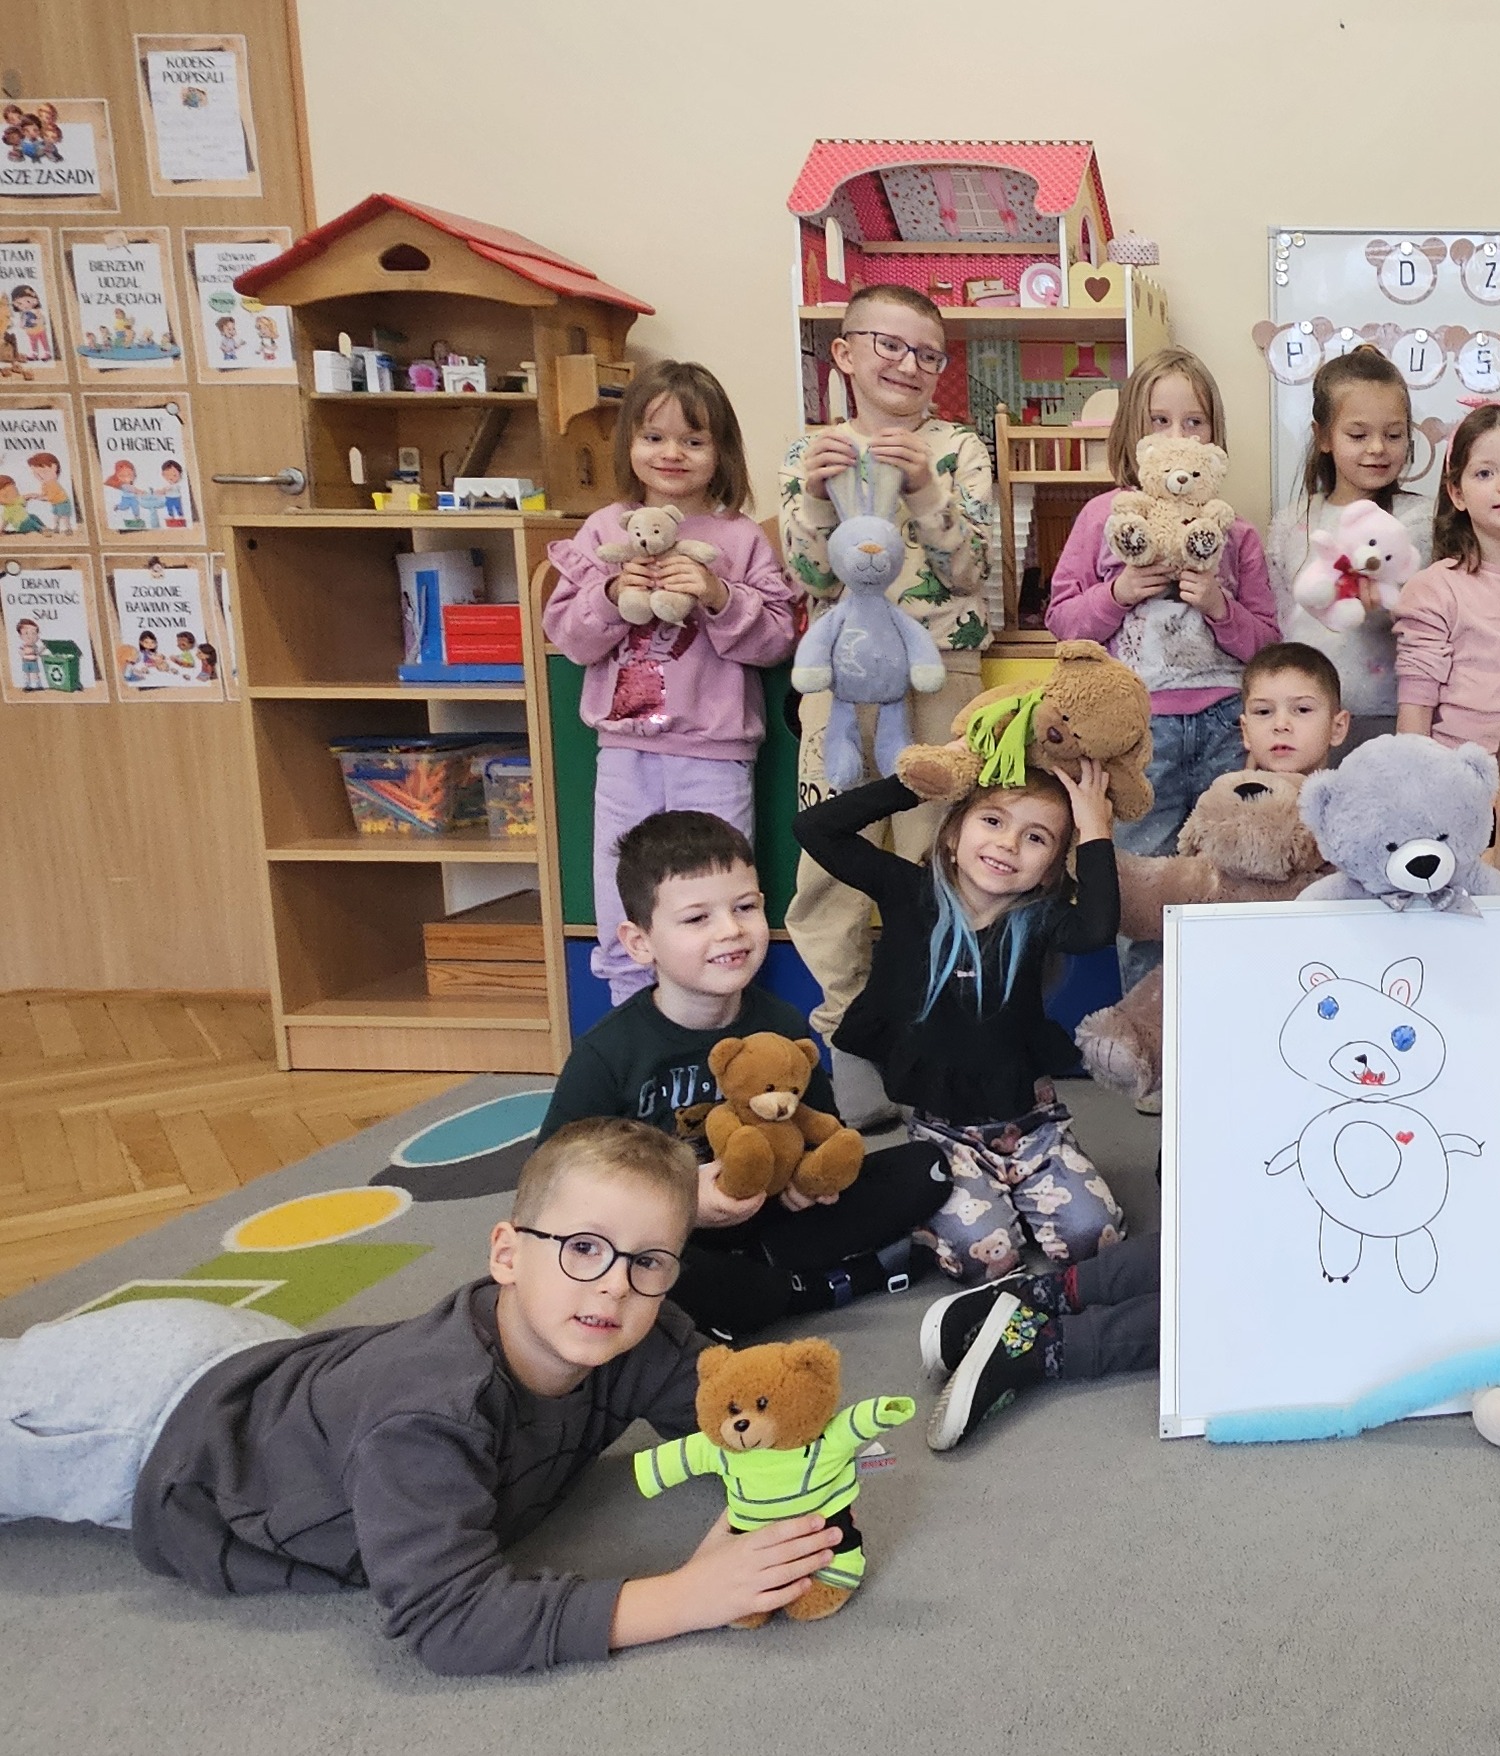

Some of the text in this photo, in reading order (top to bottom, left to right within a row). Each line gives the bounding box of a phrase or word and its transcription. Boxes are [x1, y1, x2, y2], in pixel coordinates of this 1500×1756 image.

[165, 56, 216, 69] KODEKS
[162, 71, 225, 84] PODPISALI
[0, 169, 95, 185] SZE ZASADY
[0, 250, 35, 262] TAMY
[89, 260, 145, 272] BIERZEMY
[81, 293, 92, 304] W
[112, 417, 163, 431] DBAMY
[106, 437, 175, 454] O HIGIENĘ
[21, 578, 60, 589] DBAMY
[131, 585, 182, 597] ZGODNIE
[7, 593, 16, 605] O
[136, 616, 146, 628] Z
